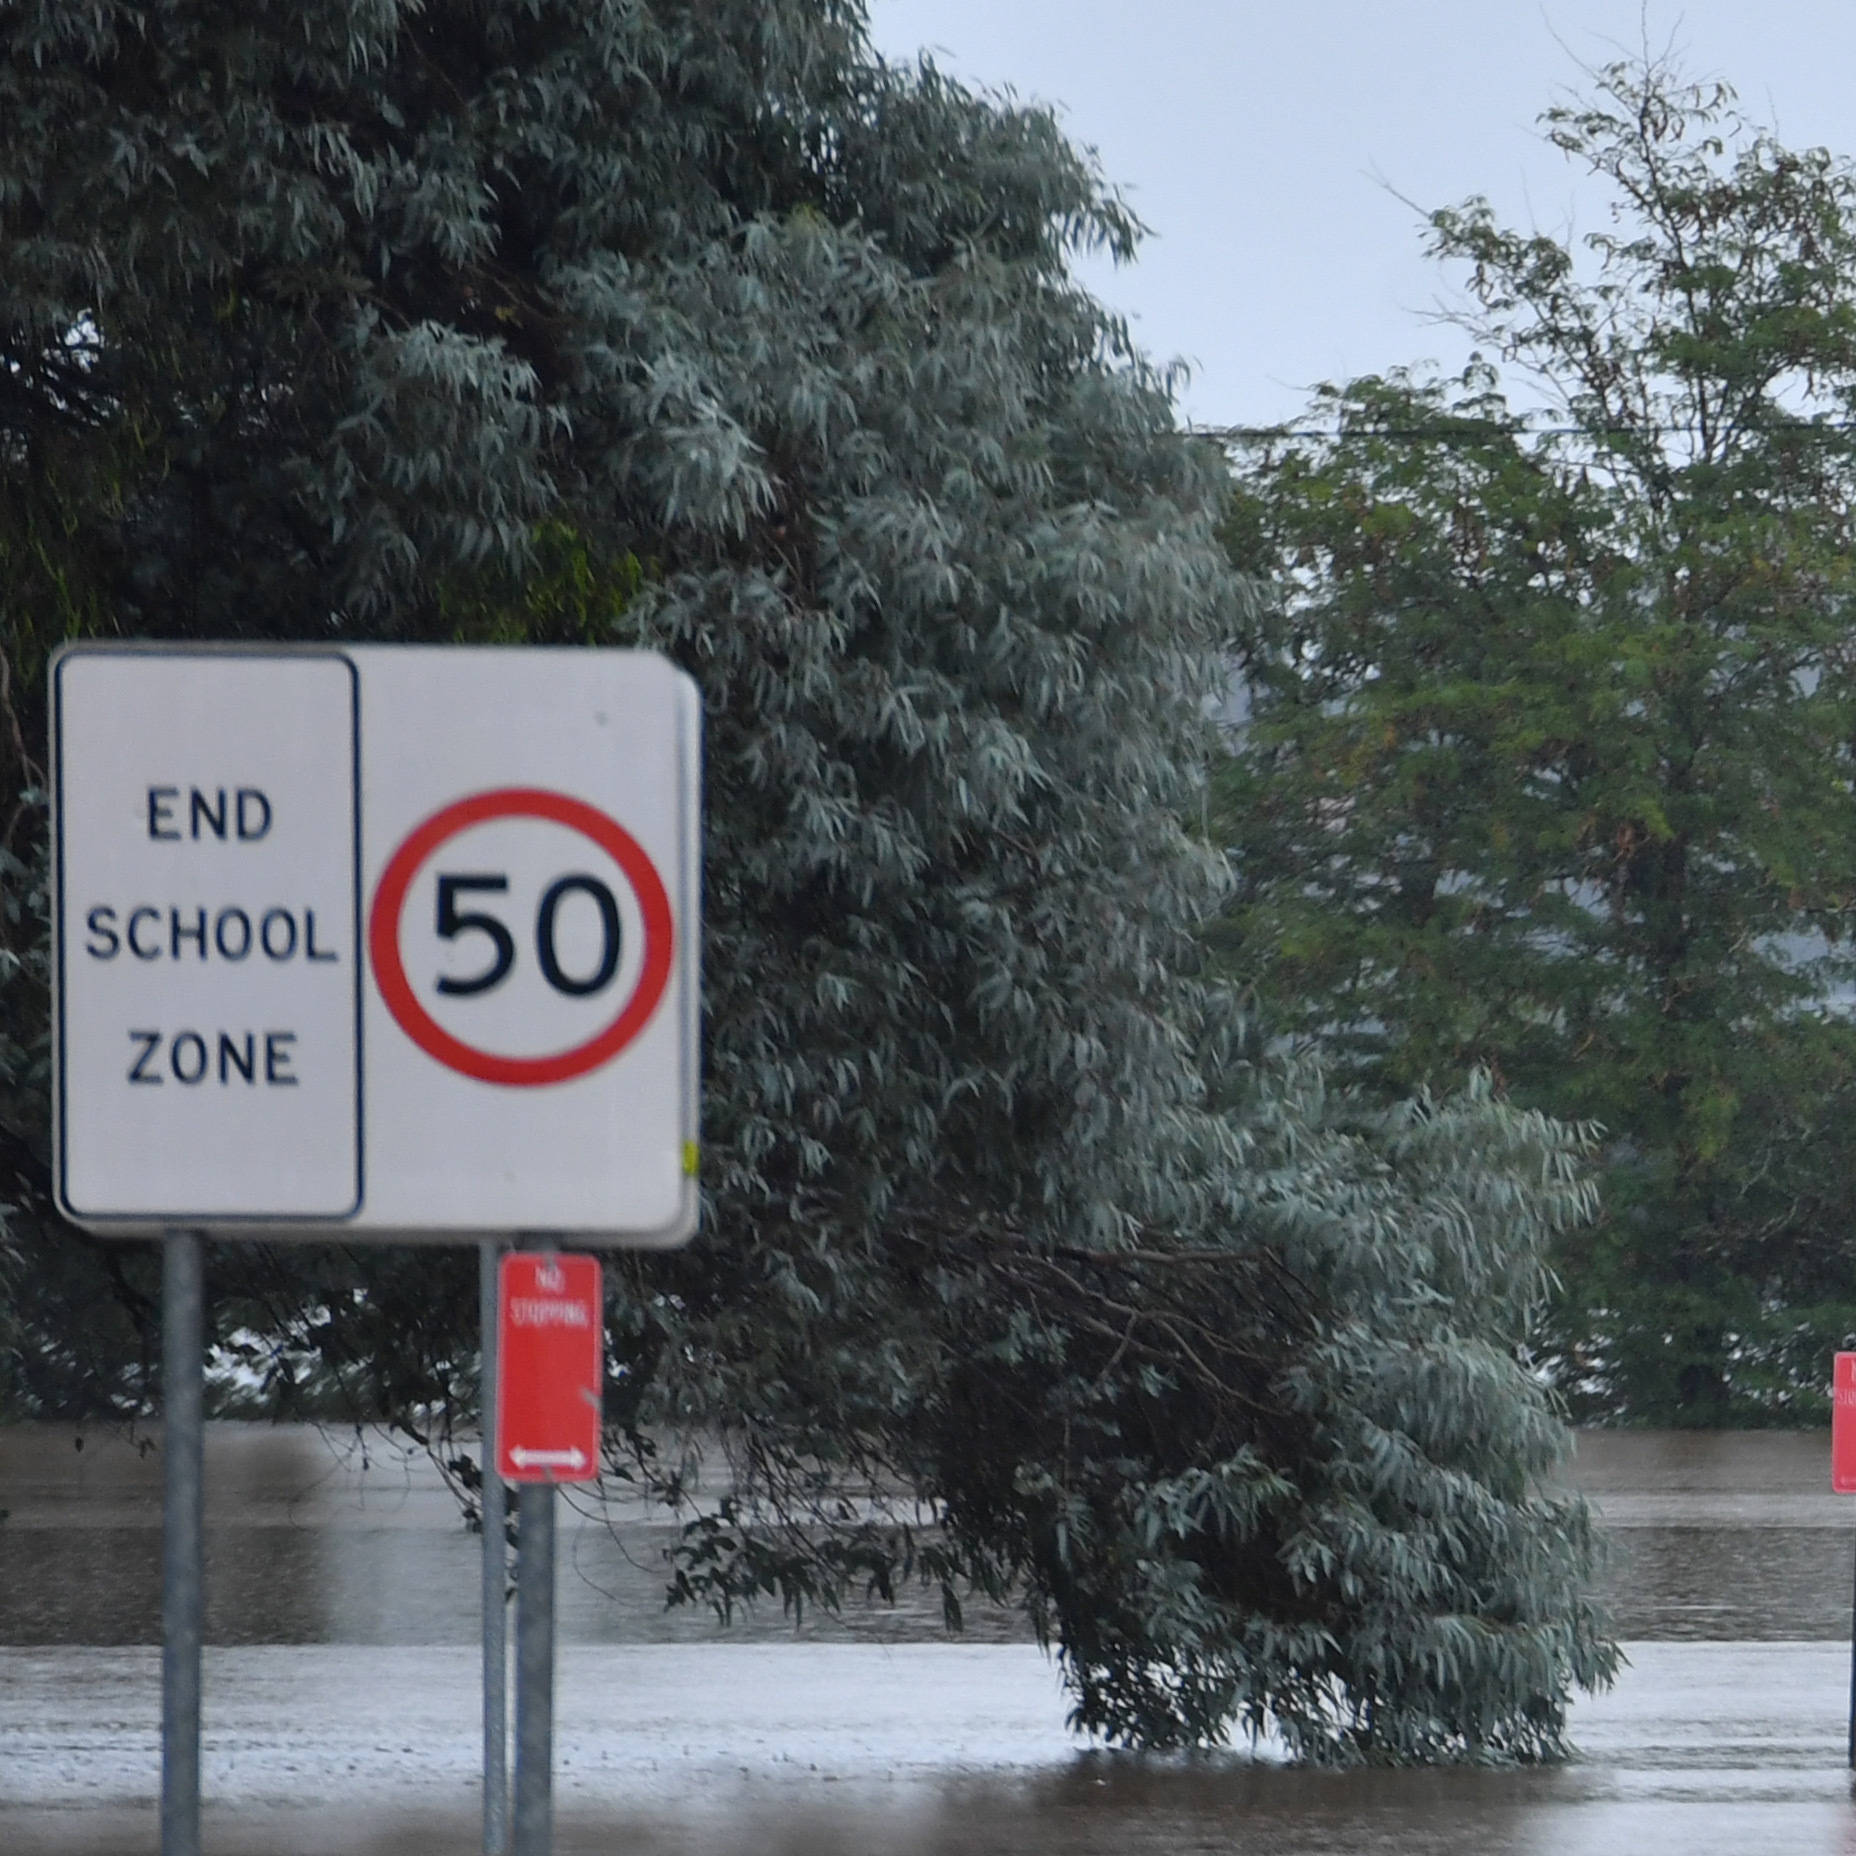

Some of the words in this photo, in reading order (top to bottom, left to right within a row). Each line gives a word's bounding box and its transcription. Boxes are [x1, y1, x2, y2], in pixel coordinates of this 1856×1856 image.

[147, 787, 273, 842] END
[86, 909, 338, 963] SCHOOL
[434, 874, 621, 998] 50
[128, 1032, 298, 1087] ZONE
[535, 1266, 566, 1293] NO
[510, 1299, 588, 1327] STOPPING
